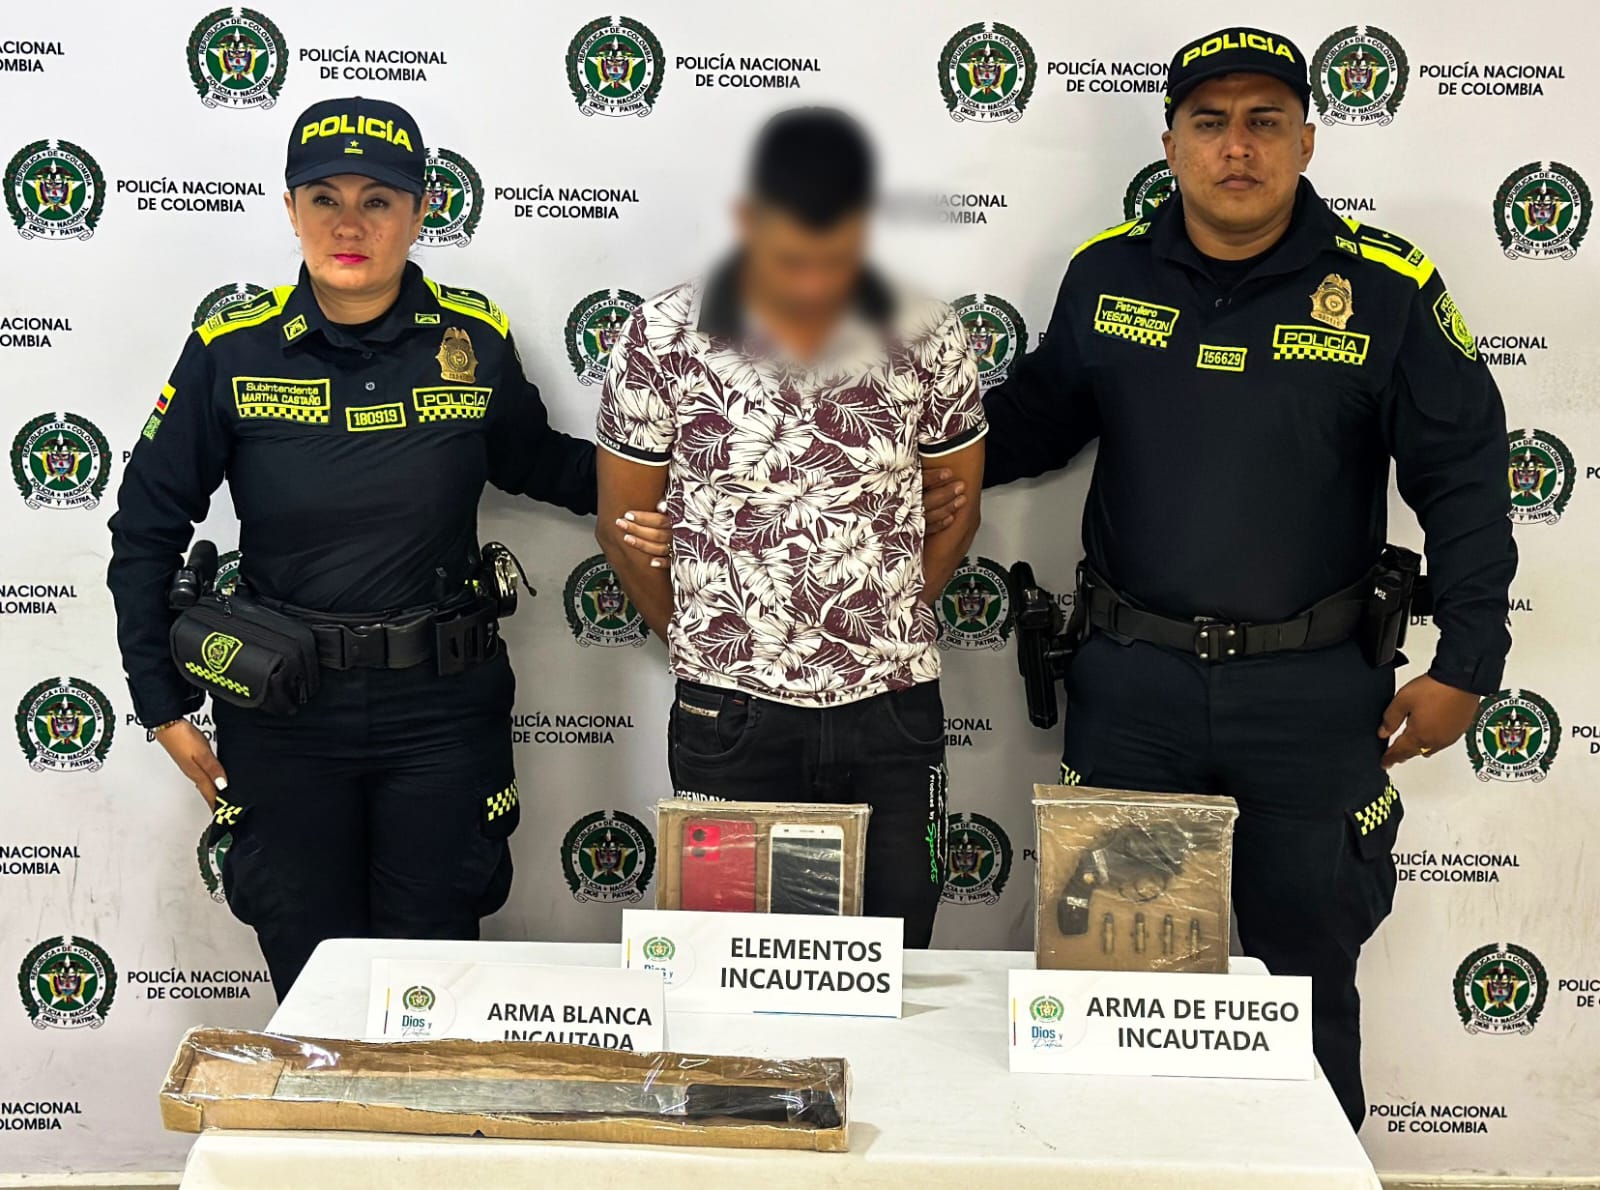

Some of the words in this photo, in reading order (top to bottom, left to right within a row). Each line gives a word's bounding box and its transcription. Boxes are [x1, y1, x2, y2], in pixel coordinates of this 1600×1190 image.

[248, 21, 275, 55] COLOMBIA
[0, 41, 64, 55] CIONAL
[626, 30, 652, 64] COLOMBIA
[998, 36, 1024, 69] COLOMBIA
[300, 45, 360, 62] POLICÍA
[365, 50, 447, 64] NACIONAL
[1370, 39, 1396, 73] COLOMBIA
[0, 59, 44, 72] MBIA
[676, 53, 735, 70] POLICÍA
[740, 58, 820, 71] NACIONAL
[1048, 59, 1106, 75] POLICÍA
[1112, 63, 1166, 76] NACION
[320, 67, 338, 79] DE
[343, 67, 426, 81] COLOMBIA
[1420, 62, 1479, 78] POLICÍA
[1484, 66, 1565, 78] NACIONAL
[240, 75, 272, 96] NACIONAL
[696, 74, 714, 87] DE
[718, 75, 800, 88] COLOMBIA
[1067, 80, 1084, 92] DE
[1089, 80, 1166, 93] COLOMBIA
[617, 83, 648, 104] NACIONAL
[1439, 83, 1457, 95] DE
[1461, 83, 1543, 95] COLOMBIA
[212, 93, 228, 103] DIOS
[242, 94, 267, 104] PATRIA
[988, 89, 1019, 110] NACIONAL
[1359, 92, 1390, 113] NACIONAL
[589, 101, 605, 111] DIOS
[619, 102, 643, 112] PATRIA
[960, 106, 976, 117] DIOS
[990, 107, 1013, 118] PATRIA
[1331, 110, 1347, 121] DIOS
[1361, 110, 1384, 121] PATRIA
[301, 114, 414, 153] POLICÍA
[65, 153, 92, 187] COLOMBIA
[117, 177, 178, 193] POLICÍA
[183, 182, 265, 195] NACIONAL
[495, 184, 554, 200] POLICÍA
[559, 189, 639, 202] NACIONAL
[1554, 175, 1580, 208] COLOMBIA
[138, 198, 156, 210] DE
[161, 198, 245, 212] COLOMBIA
[935, 194, 1007, 207] ACIONAL
[1324, 198, 1376, 211] CIONAL
[57, 207, 89, 227] NACIONAL
[515, 205, 532, 217] DE
[537, 205, 619, 219] COLOMBIA
[937, 211, 987, 224] OMBIA
[29, 224, 45, 234] DIOS
[60, 225, 84, 235] PATRIA
[1543, 227, 1574, 247] NACIONAL
[1514, 244, 1530, 255] DIOS
[1544, 245, 1567, 255] PATRIA
[1115, 301, 1158, 318] Patrullero
[0, 318, 72, 331] ACIONAL
[1133, 315, 1170, 331] PINZON
[0, 334, 51, 347] OMBIA
[1284, 332, 1358, 353] POLICÍA
[1476, 336, 1548, 350] ACIONAL
[1203, 350, 1241, 366] 156629
[1482, 353, 1527, 367] OMBIA
[246, 382, 318, 395] Subintendente
[242, 393, 279, 403] MARTHA
[281, 394, 321, 406] CASTAÑO
[423, 392, 485, 407] POLICÍA
[354, 409, 398, 426] 180919
[71, 425, 98, 458] COLOMBIA
[63, 477, 95, 497] NACIONAL
[35, 494, 52, 504] DIOS
[66, 495, 90, 505] PATRIA
[0, 585, 77, 597] NACIONAL
[0, 602, 56, 614] LOMBIA
[511, 712, 551, 727] LICÍA
[556, 715, 634, 727] NACIONAL
[944, 719, 992, 733] IONAL
[513, 732, 530, 743] DE
[535, 732, 614, 744] COLOMBIA
[0, 846, 80, 858] NACIONAL
[1442, 854, 1519, 867] NACIONAL
[0, 862, 60, 874] LOMBIA
[1398, 869, 1416, 881] DE
[1420, 870, 1499, 882] COLOMBIA
[731, 937, 882, 962] ELEMENTOS
[128, 968, 186, 983] POLICÍA
[190, 971, 271, 984] NACIONAL
[720, 967, 891, 994] INCAUTADOS
[148, 987, 165, 999] DE
[170, 987, 250, 999] COLOMBIA
[1559, 980, 1600, 992] POLIC
[1577, 996, 1594, 1007] DE
[487, 1001, 555, 1024] ARMA
[563, 1005, 652, 1026] BLANCA
[1086, 997, 1165, 1018] ARMA
[1174, 999, 1206, 1020] DE
[1215, 1001, 1299, 1022] FUEGO
[402, 1015, 425, 1028] Dios
[427, 1022, 433, 1030] y
[1031, 1026, 1056, 1039] Dios
[1118, 1027, 1270, 1052] INCAUTADA
[2, 1102, 81, 1114] NACIONAL
[1370, 1102, 1426, 1117] POLICÍA
[1431, 1105, 1507, 1118] NACIONAL
[0, 1118, 61, 1130] LOMBIA
[1388, 1121, 1405, 1132] DE
[1410, 1121, 1488, 1133] COLOMBIA
